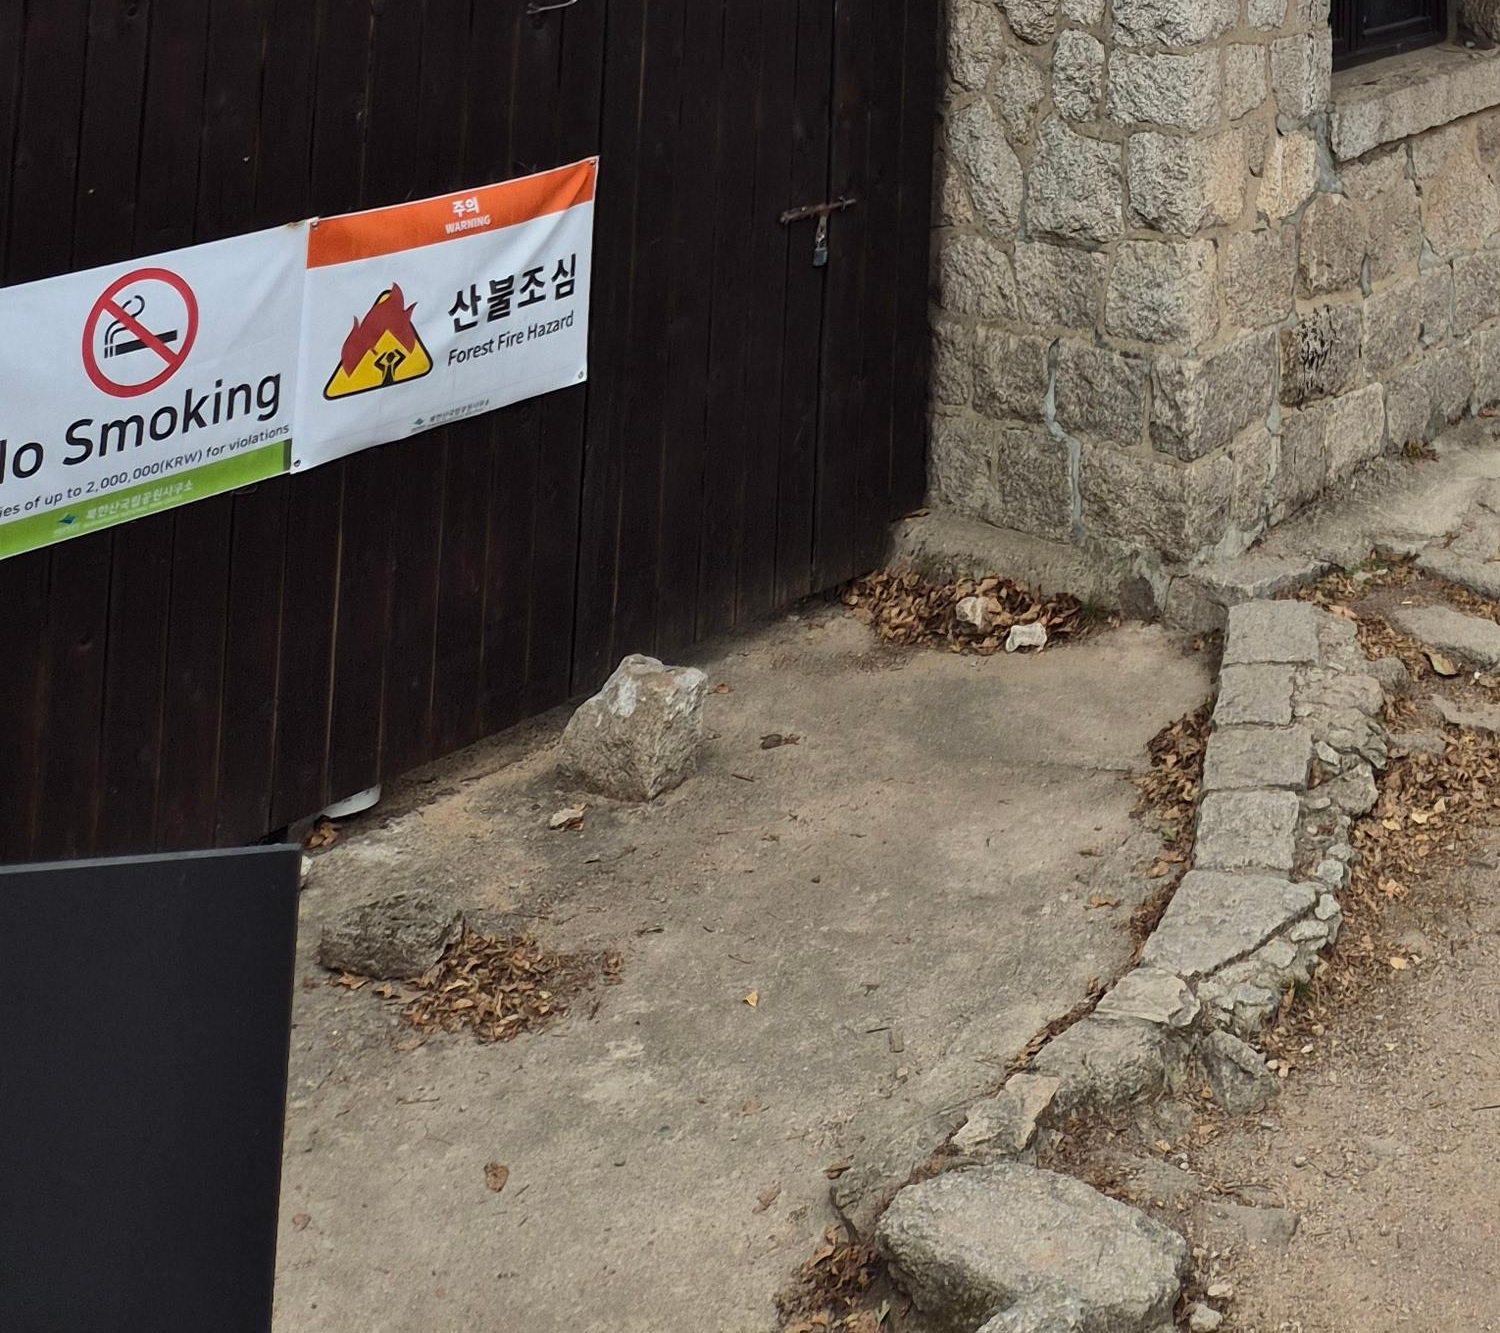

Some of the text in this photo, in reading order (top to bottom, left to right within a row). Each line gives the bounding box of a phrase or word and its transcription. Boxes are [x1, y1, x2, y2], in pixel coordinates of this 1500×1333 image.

[444, 214, 491, 235] WARNING
[452, 196, 480, 218] 주의
[448, 253, 576, 333] 산불조심
[447, 309, 574, 367] Forest Fire Hazard
[0, 372, 281, 485] o Smoking
[24, 496, 41, 511] of
[44, 493, 63, 507] up
[67, 487, 82, 499] to
[206, 444, 226, 458] for
[228, 424, 290, 452] violations
